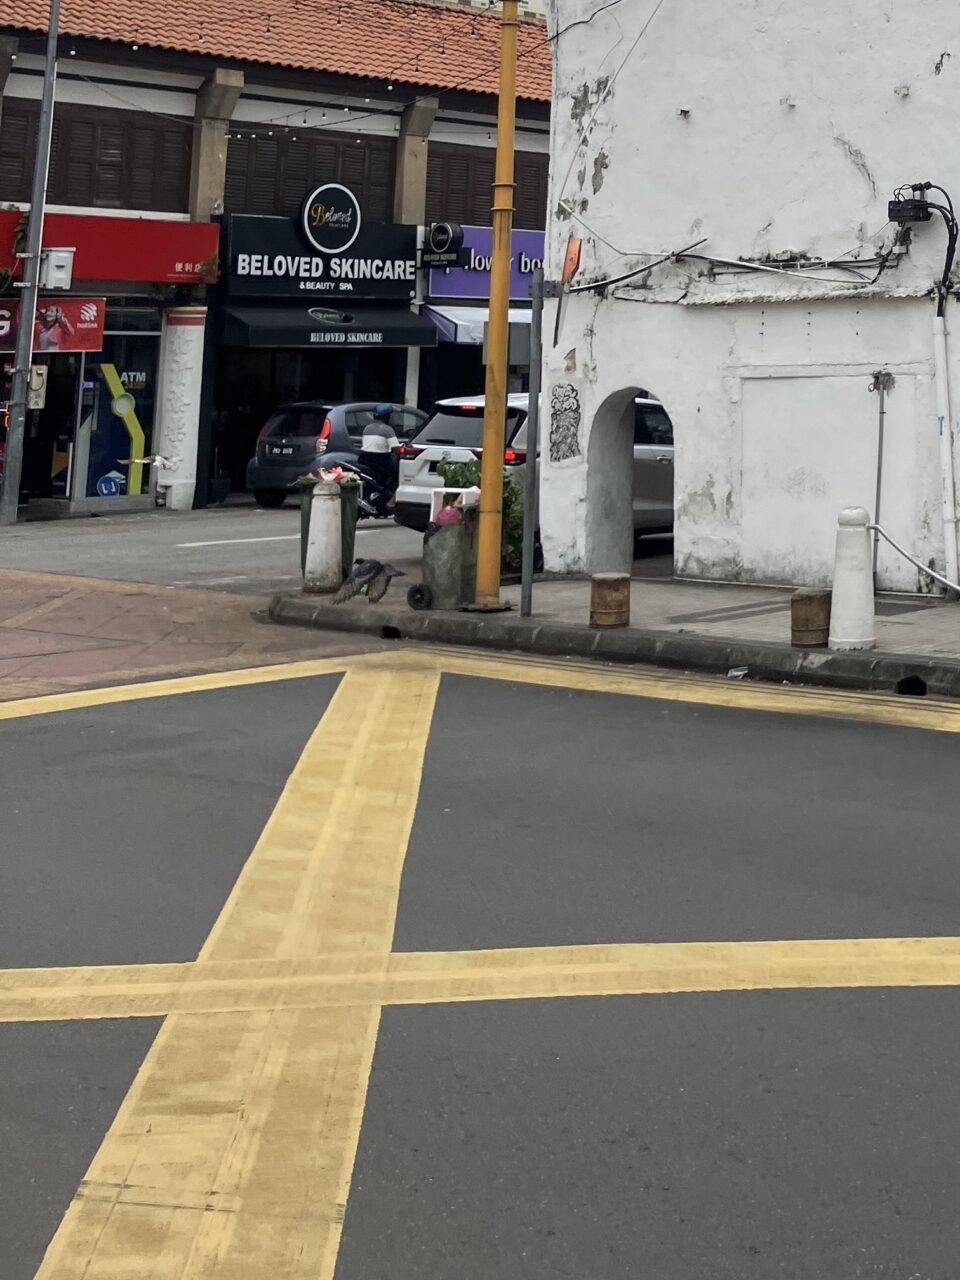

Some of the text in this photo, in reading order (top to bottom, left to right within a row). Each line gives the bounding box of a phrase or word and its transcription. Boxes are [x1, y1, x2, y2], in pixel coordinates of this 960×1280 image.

[311, 203, 352, 226] Beloved
[237, 253, 416, 280] BELOVED SKINCARE
[464, 247, 545, 273] lowr bo
[300, 281, 353, 291] & BEAUTY SPA
[310, 332, 383, 343] BELOVED SKINCARE
[120, 371, 147, 383] ATM
